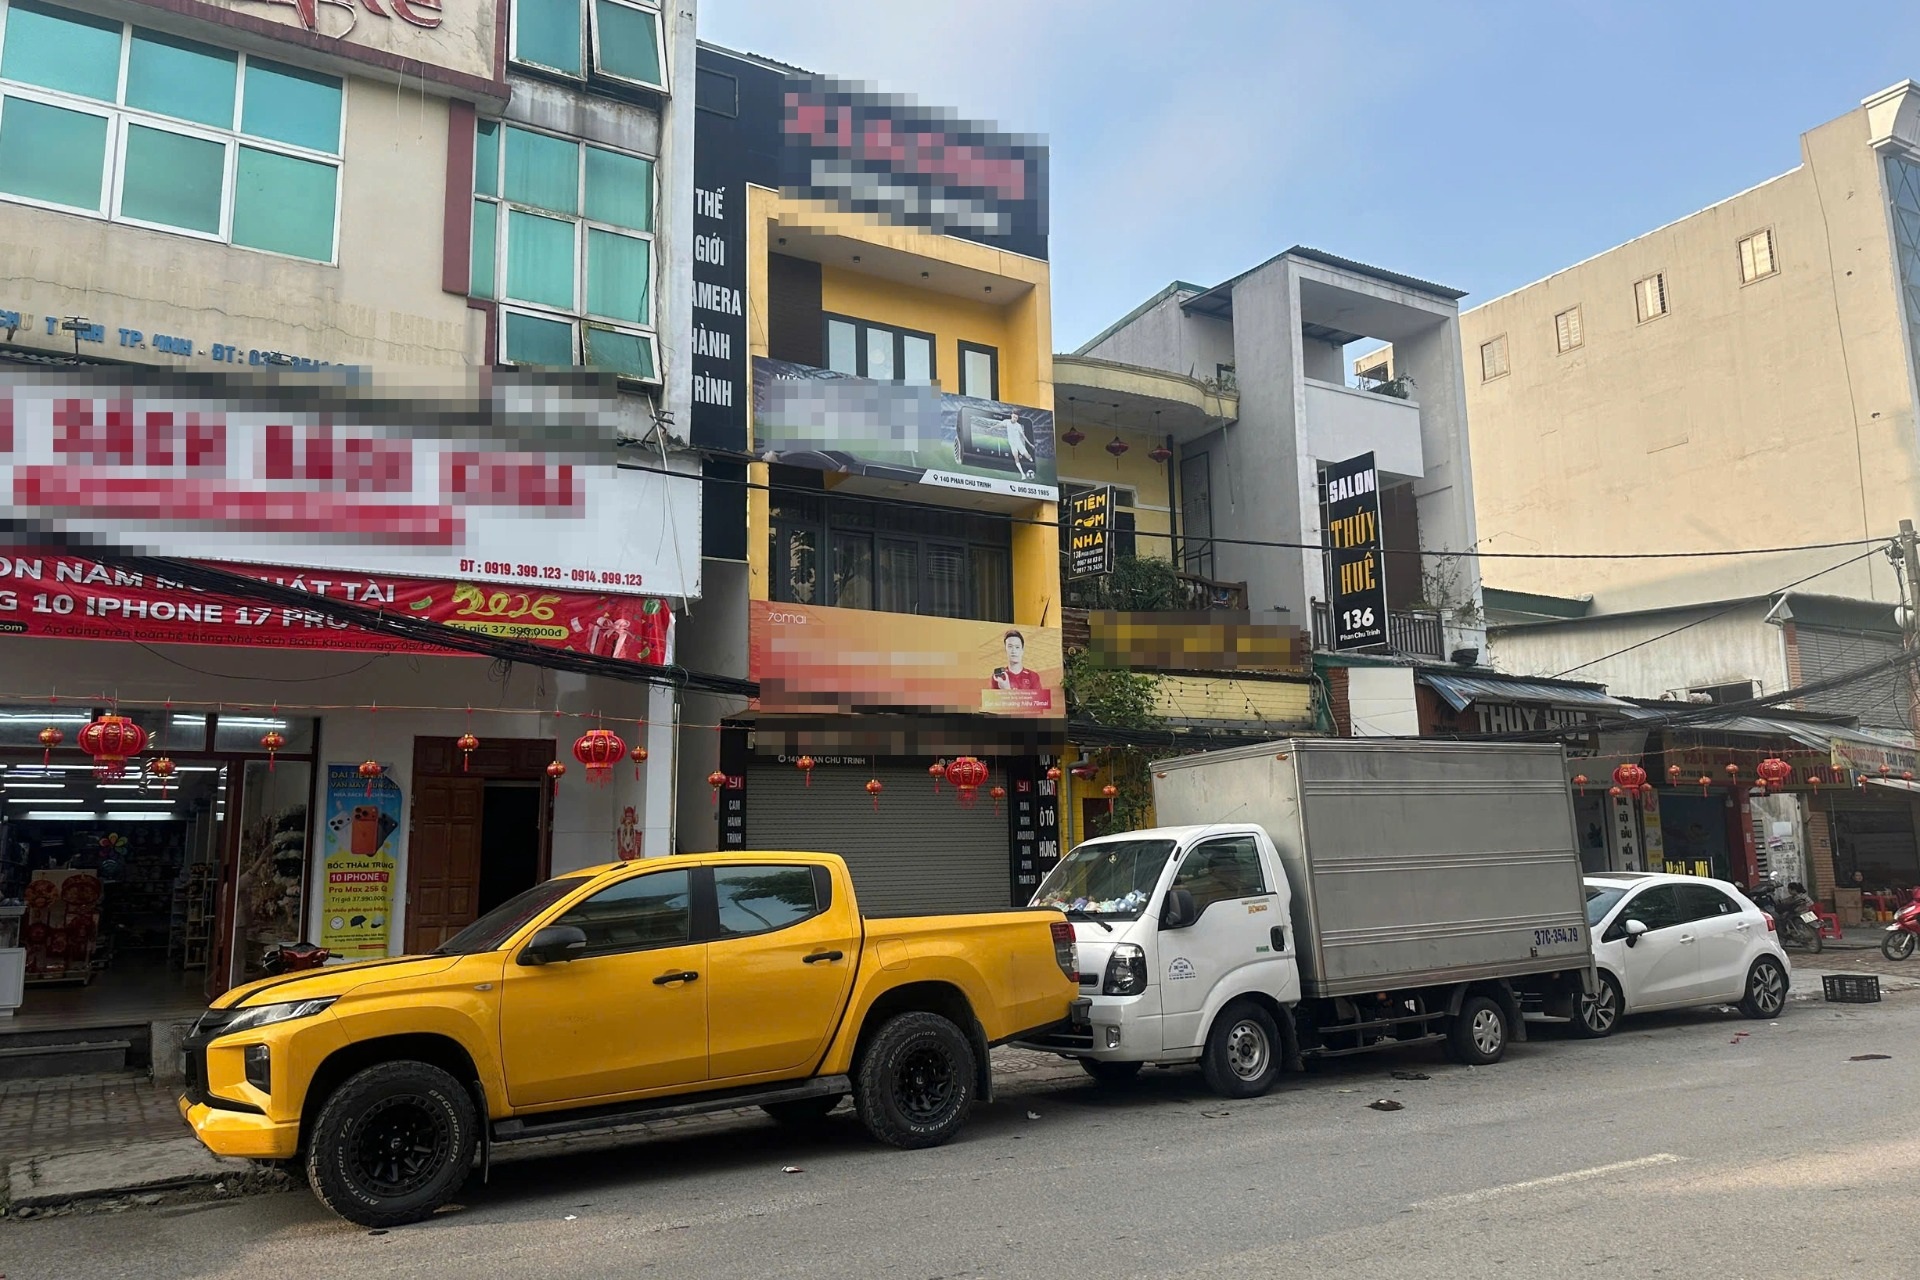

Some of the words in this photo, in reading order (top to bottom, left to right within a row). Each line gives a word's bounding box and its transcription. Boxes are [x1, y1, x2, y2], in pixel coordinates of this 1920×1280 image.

[696, 186, 726, 220] THẾ
[695, 232, 725, 267] GIỚI
[692, 280, 742, 317] AMERA
[692, 371, 732, 408] RÌNH
[1328, 468, 1375, 504] SALON
[1074, 494, 1106, 513] TIỆM
[1330, 506, 1376, 549] THÚY
[459, 559, 475, 573] ĐT
[484, 561, 562, 580] 0919.399.123
[571, 569, 643, 586] 0914.999.123
[1340, 545, 1376, 596] HUẾ
[340, 578, 395, 603] TÀI
[32, 593, 74, 614] 10
[86, 596, 223, 623] IPHONE
[235, 606, 272, 626] 17
[767, 612, 807, 625] 70mai
[1343, 607, 1375, 631] 136
[1340, 632, 1354, 642] Phan
[1354, 631, 1366, 640] Chu
[1039, 836, 1057, 858] HÙNG
[331, 874, 342, 882] 10
[343, 872, 380, 882] IPHONE
[1665, 860, 1686, 876] Nail
[1694, 860, 1710, 878] Mi
[1534, 927, 1579, 946] 37C-354.79
